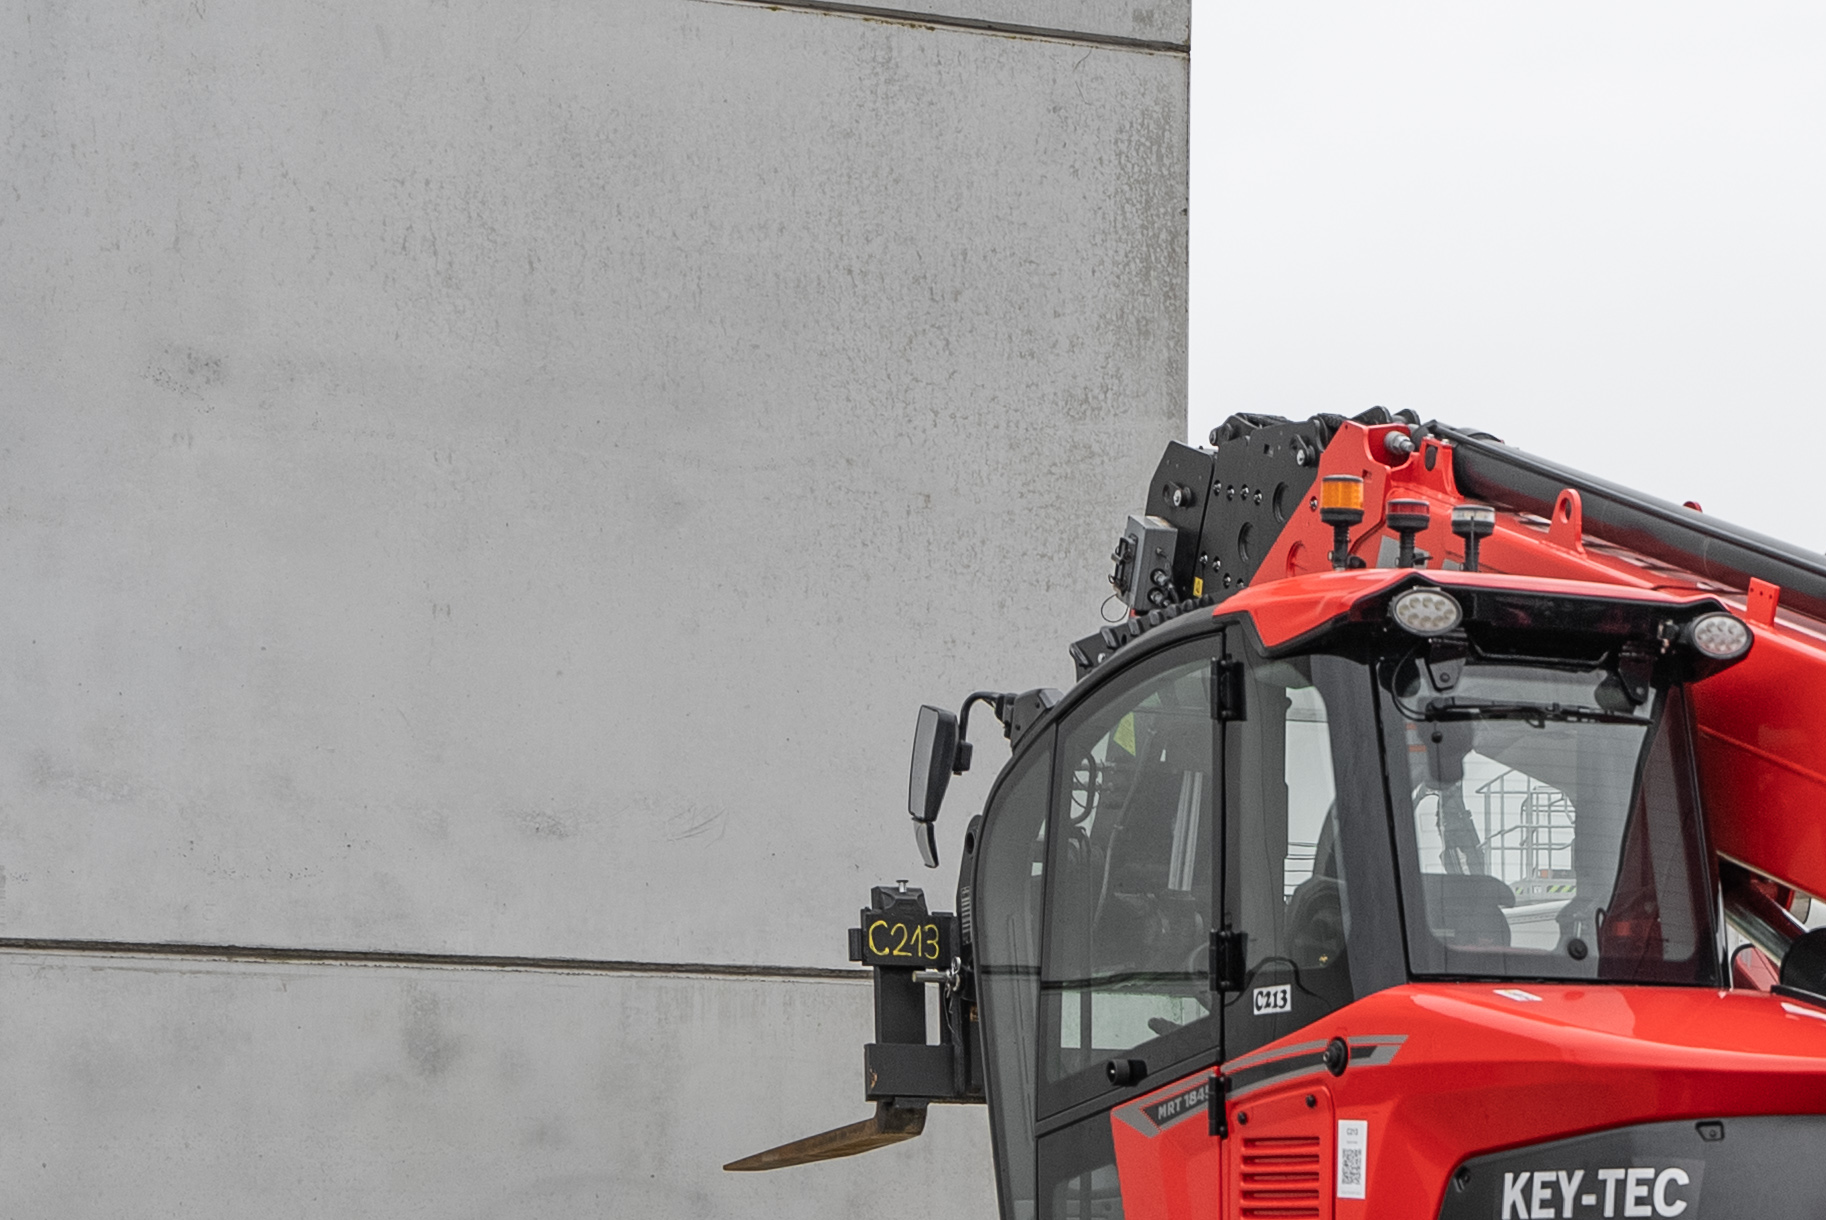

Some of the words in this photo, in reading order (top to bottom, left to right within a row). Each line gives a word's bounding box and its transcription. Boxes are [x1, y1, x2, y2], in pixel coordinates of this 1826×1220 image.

[868, 920, 939, 959] C213
[1254, 988, 1288, 1012] C213
[1158, 1096, 1182, 1120] MRT
[1501, 1167, 1690, 1220] KEY-TEC
